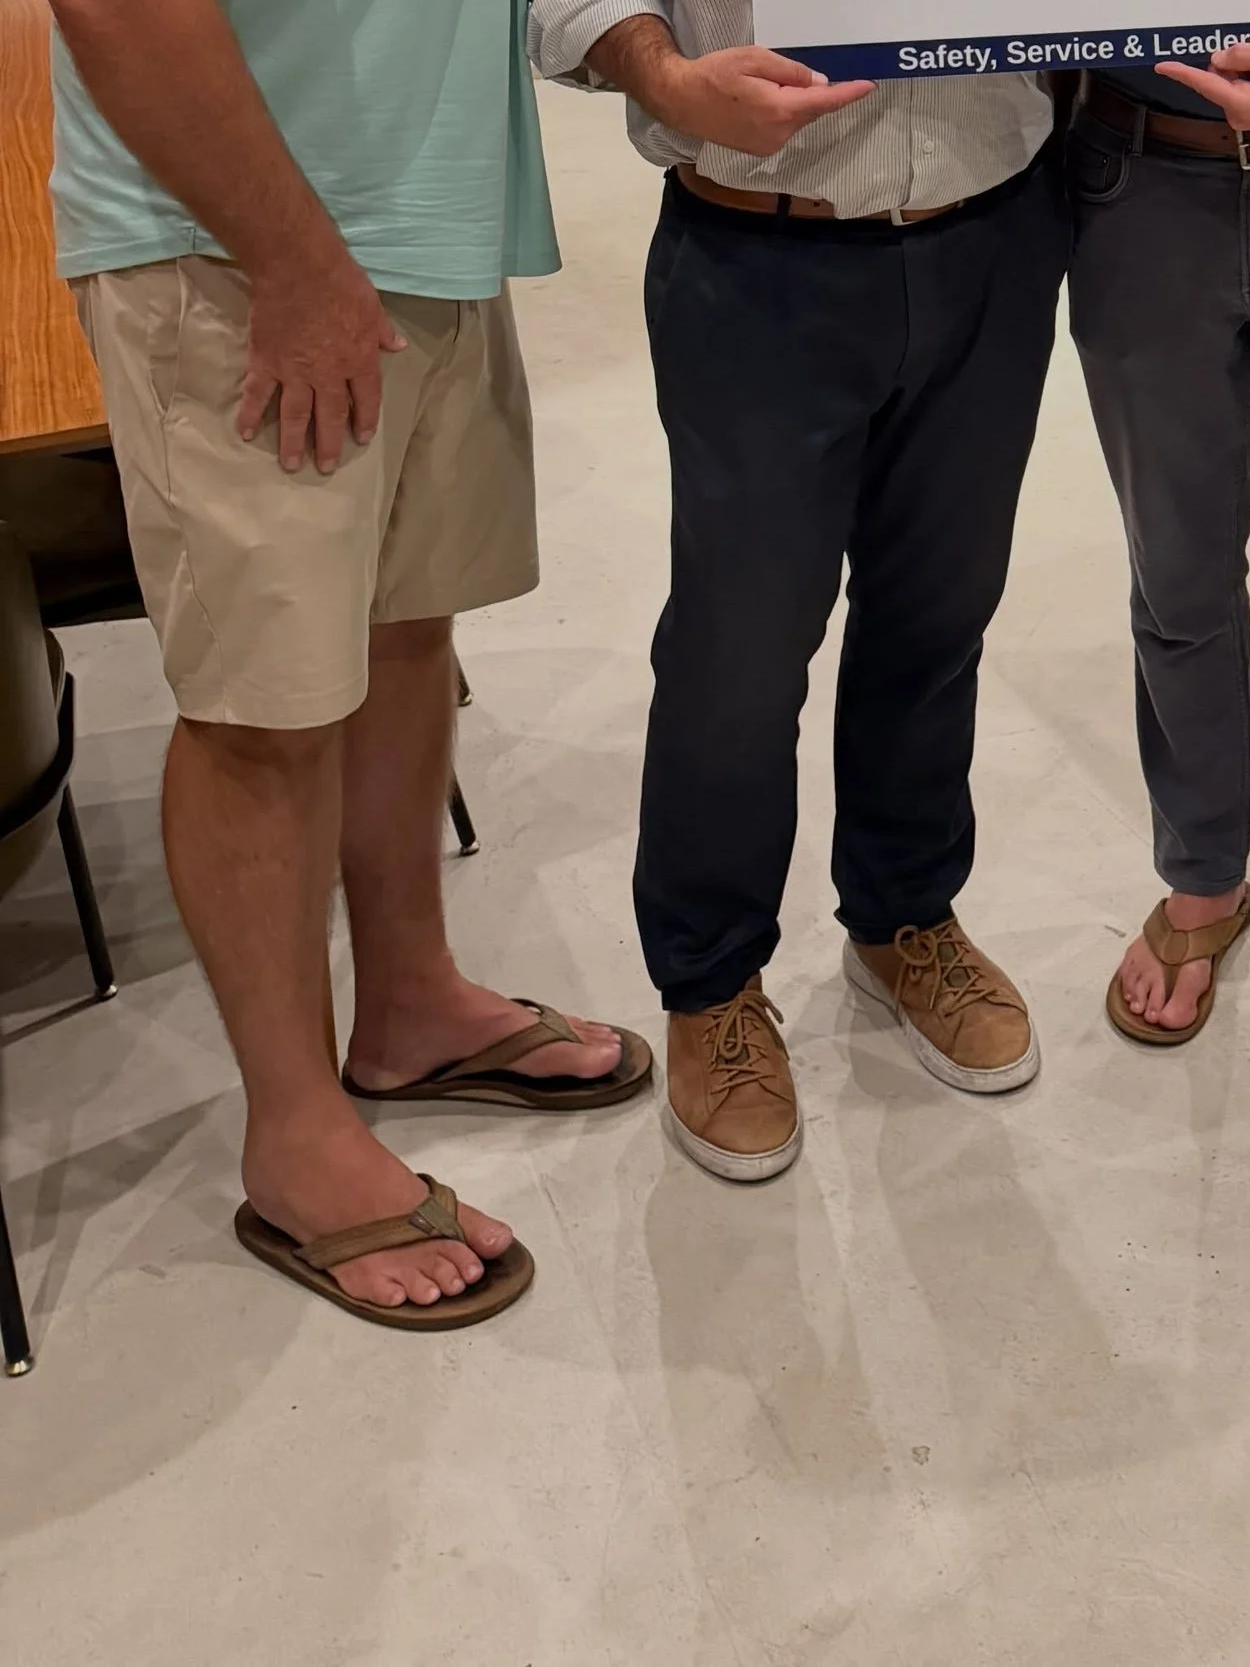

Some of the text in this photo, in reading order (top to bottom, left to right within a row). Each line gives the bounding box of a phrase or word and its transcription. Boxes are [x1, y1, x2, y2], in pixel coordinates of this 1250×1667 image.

[899, 43, 998, 73] Safety,
[1007, 34, 1114, 64] Service
[1123, 34, 1145, 58] &
